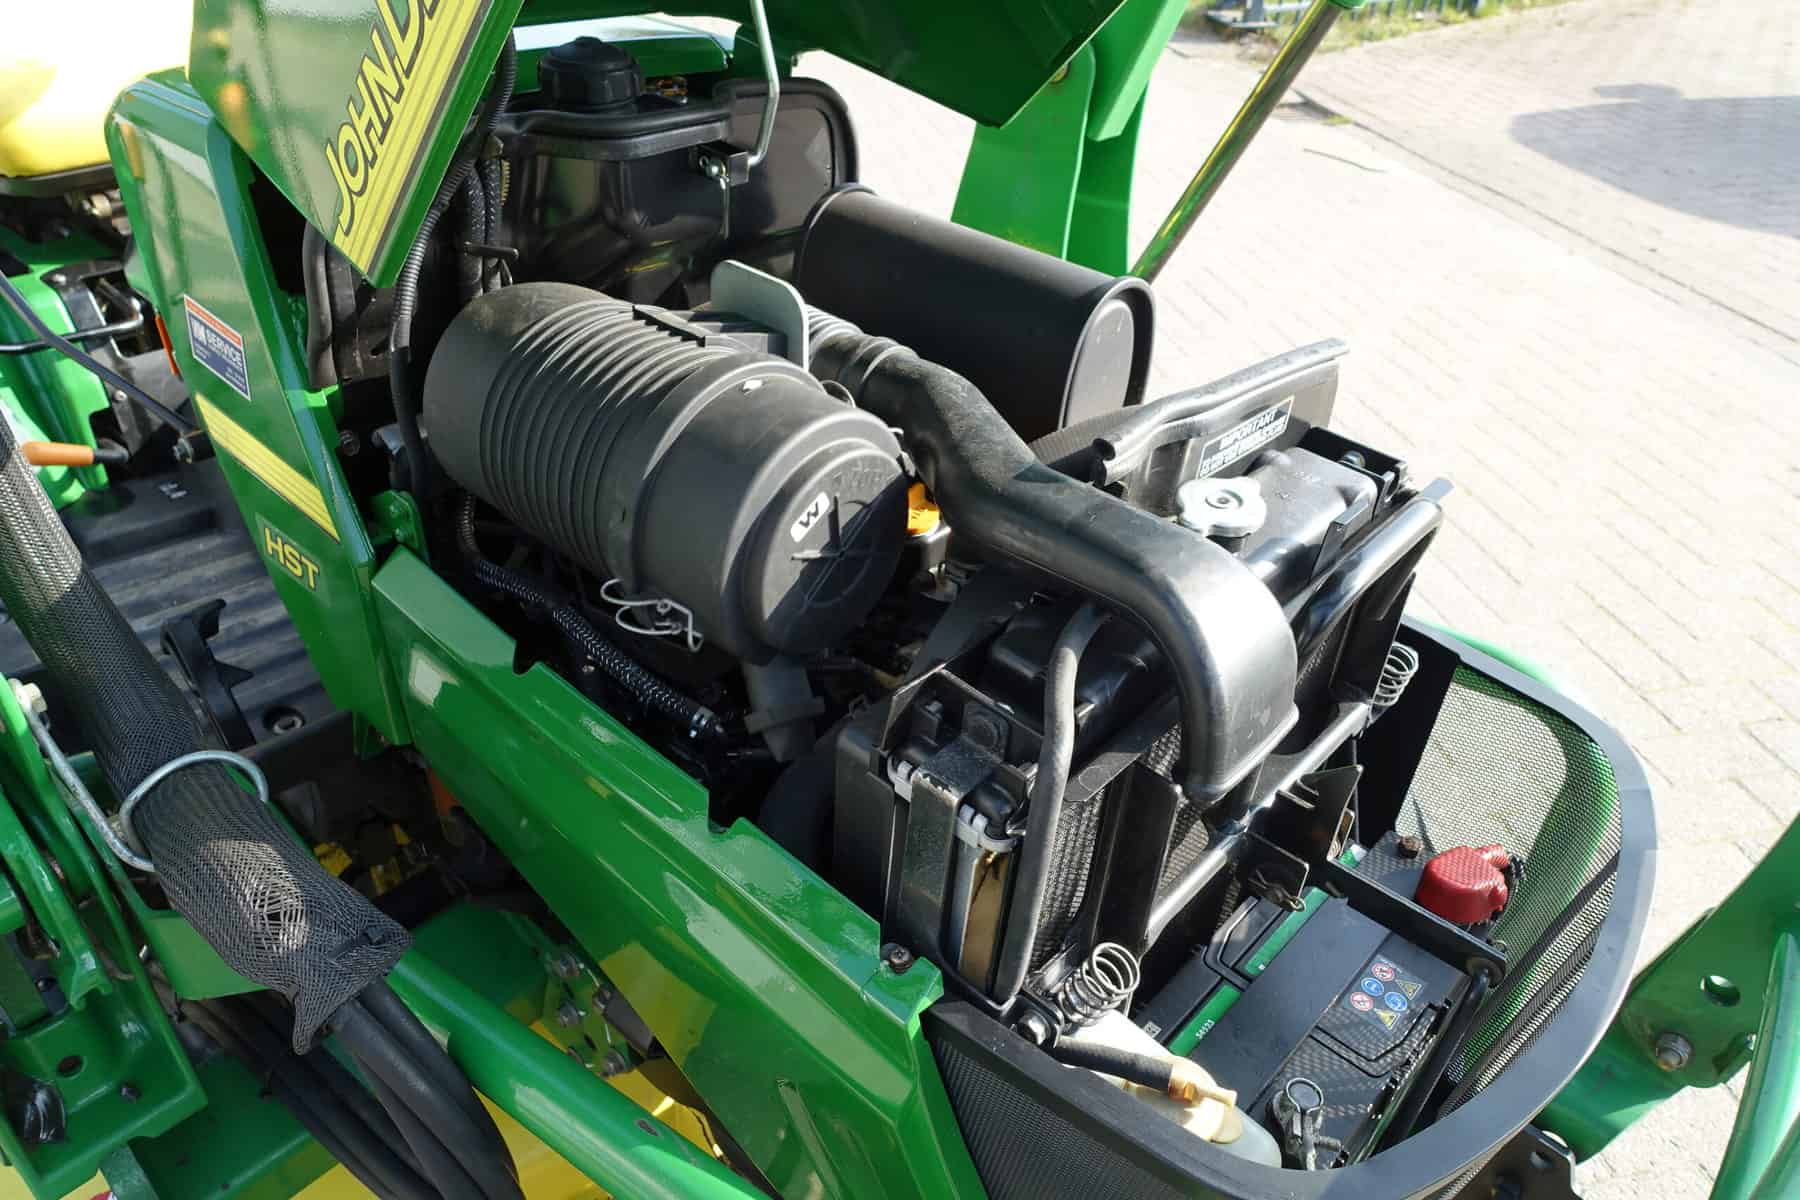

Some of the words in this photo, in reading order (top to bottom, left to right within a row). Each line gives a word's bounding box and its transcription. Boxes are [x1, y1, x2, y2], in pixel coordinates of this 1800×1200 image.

[326, 22, 405, 237] JOHN
[374, 0, 441, 80] D
[1219, 407, 1279, 451] IMPORTANT
[264, 527, 320, 590] HST
